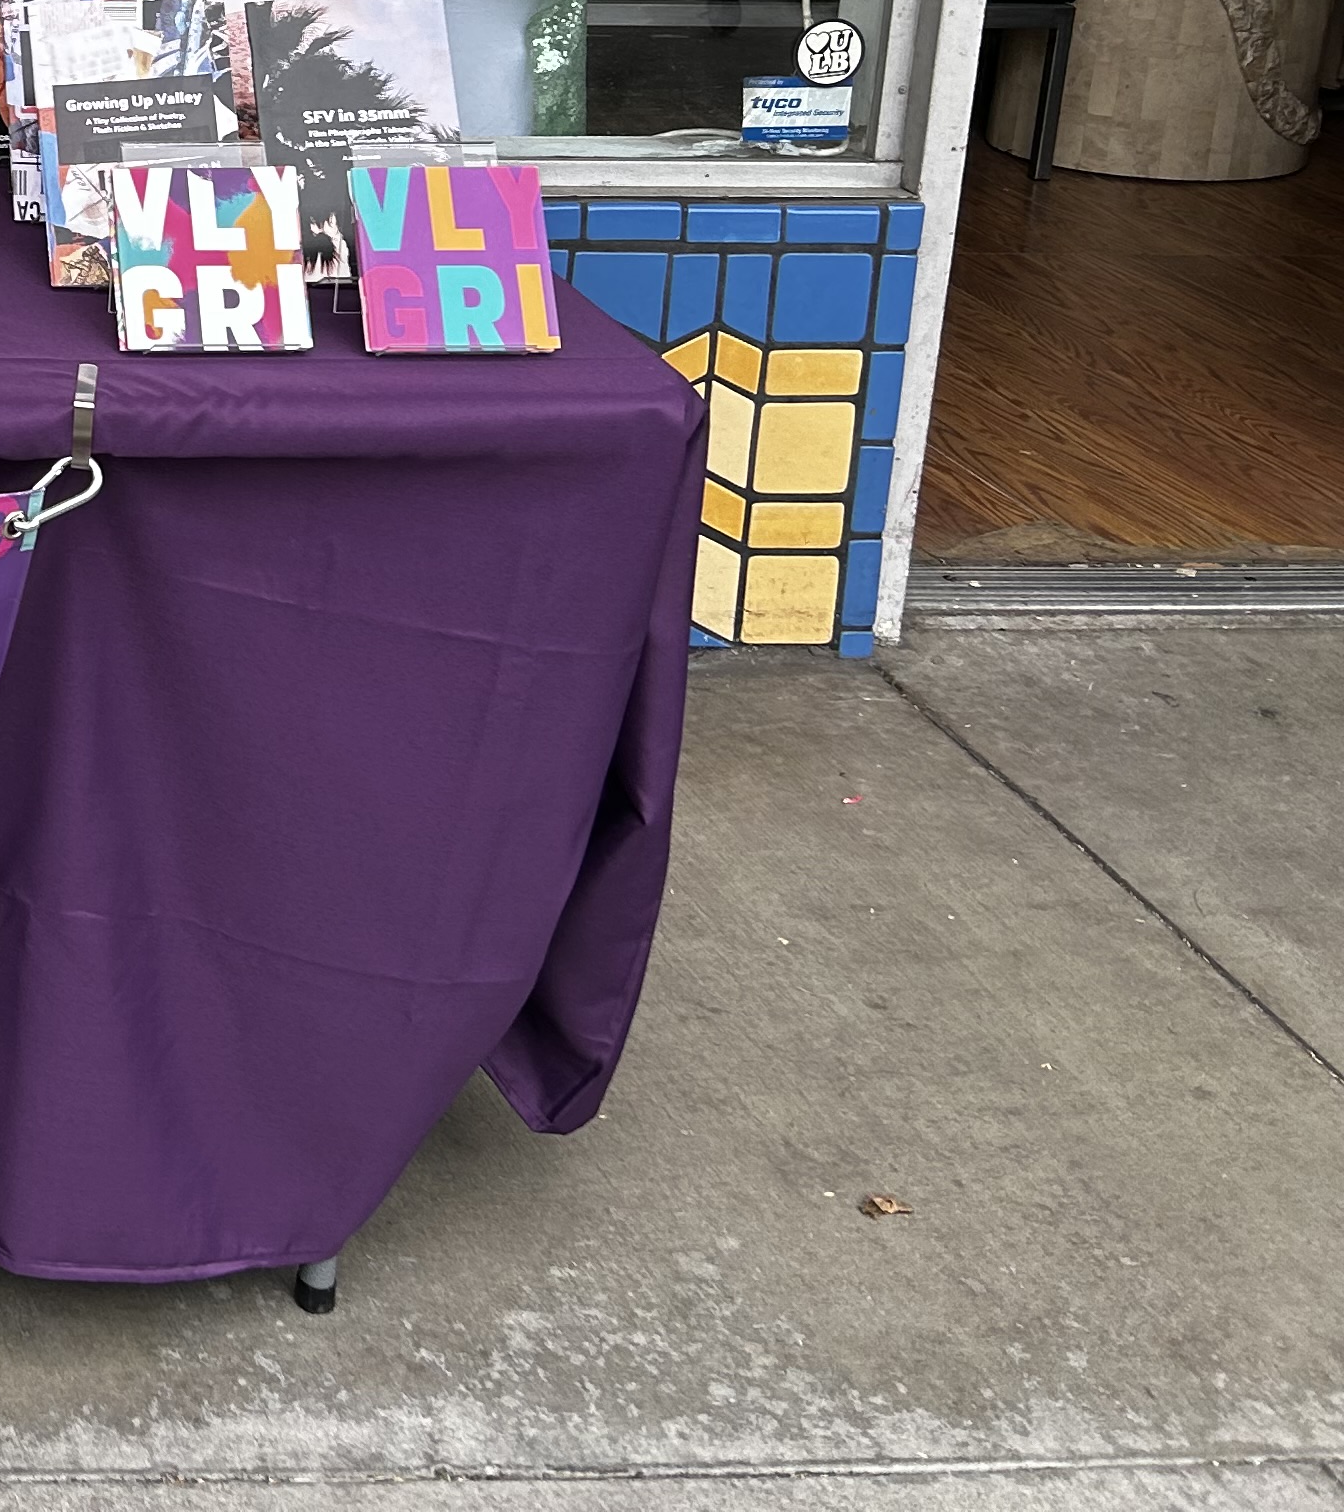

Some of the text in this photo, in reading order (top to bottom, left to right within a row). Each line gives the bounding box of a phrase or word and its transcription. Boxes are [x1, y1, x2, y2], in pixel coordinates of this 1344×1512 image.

[809, 52, 851, 74] LB
[66, 91, 203, 112] Growing Up Valley
[750, 95, 802, 112] tyco
[302, 108, 411, 125] SFV in 35mm
[773, 108, 845, 117] Integrated Security
[113, 166, 299, 251] VLY
[351, 166, 540, 251] VLY
[361, 265, 561, 352] GRL
